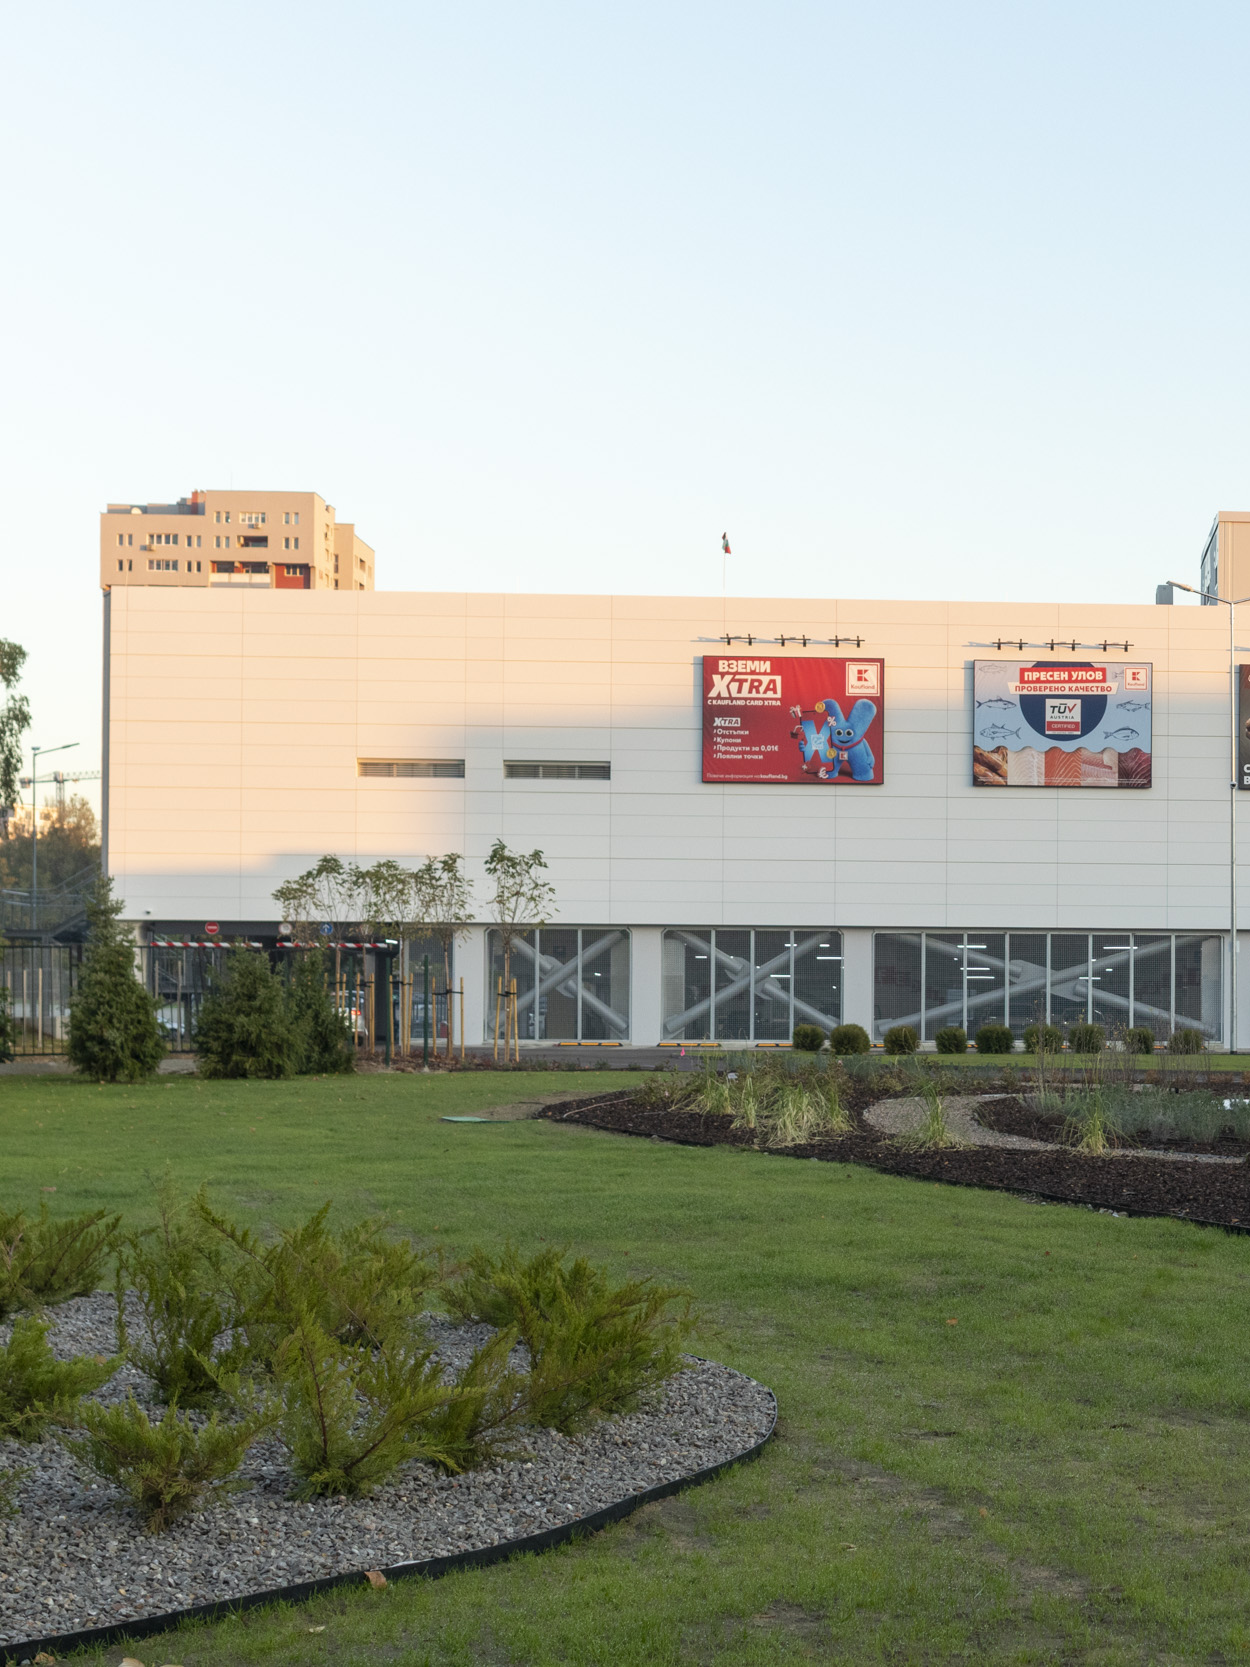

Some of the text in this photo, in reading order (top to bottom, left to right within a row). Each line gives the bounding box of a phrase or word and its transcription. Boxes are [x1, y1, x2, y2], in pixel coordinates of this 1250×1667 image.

[718, 659, 771, 673] ВЗЕМИ
[1024, 671, 1103, 681] ПРЕСЕН УЛОВ
[707, 674, 782, 698] XTRA
[1014, 685, 1113, 693] ПРОВЕРЕНО КАЧЕСТВО
[713, 717, 741, 727] XTRA
[717, 736, 742, 744] Купони
[717, 744, 750, 752] Продукти
